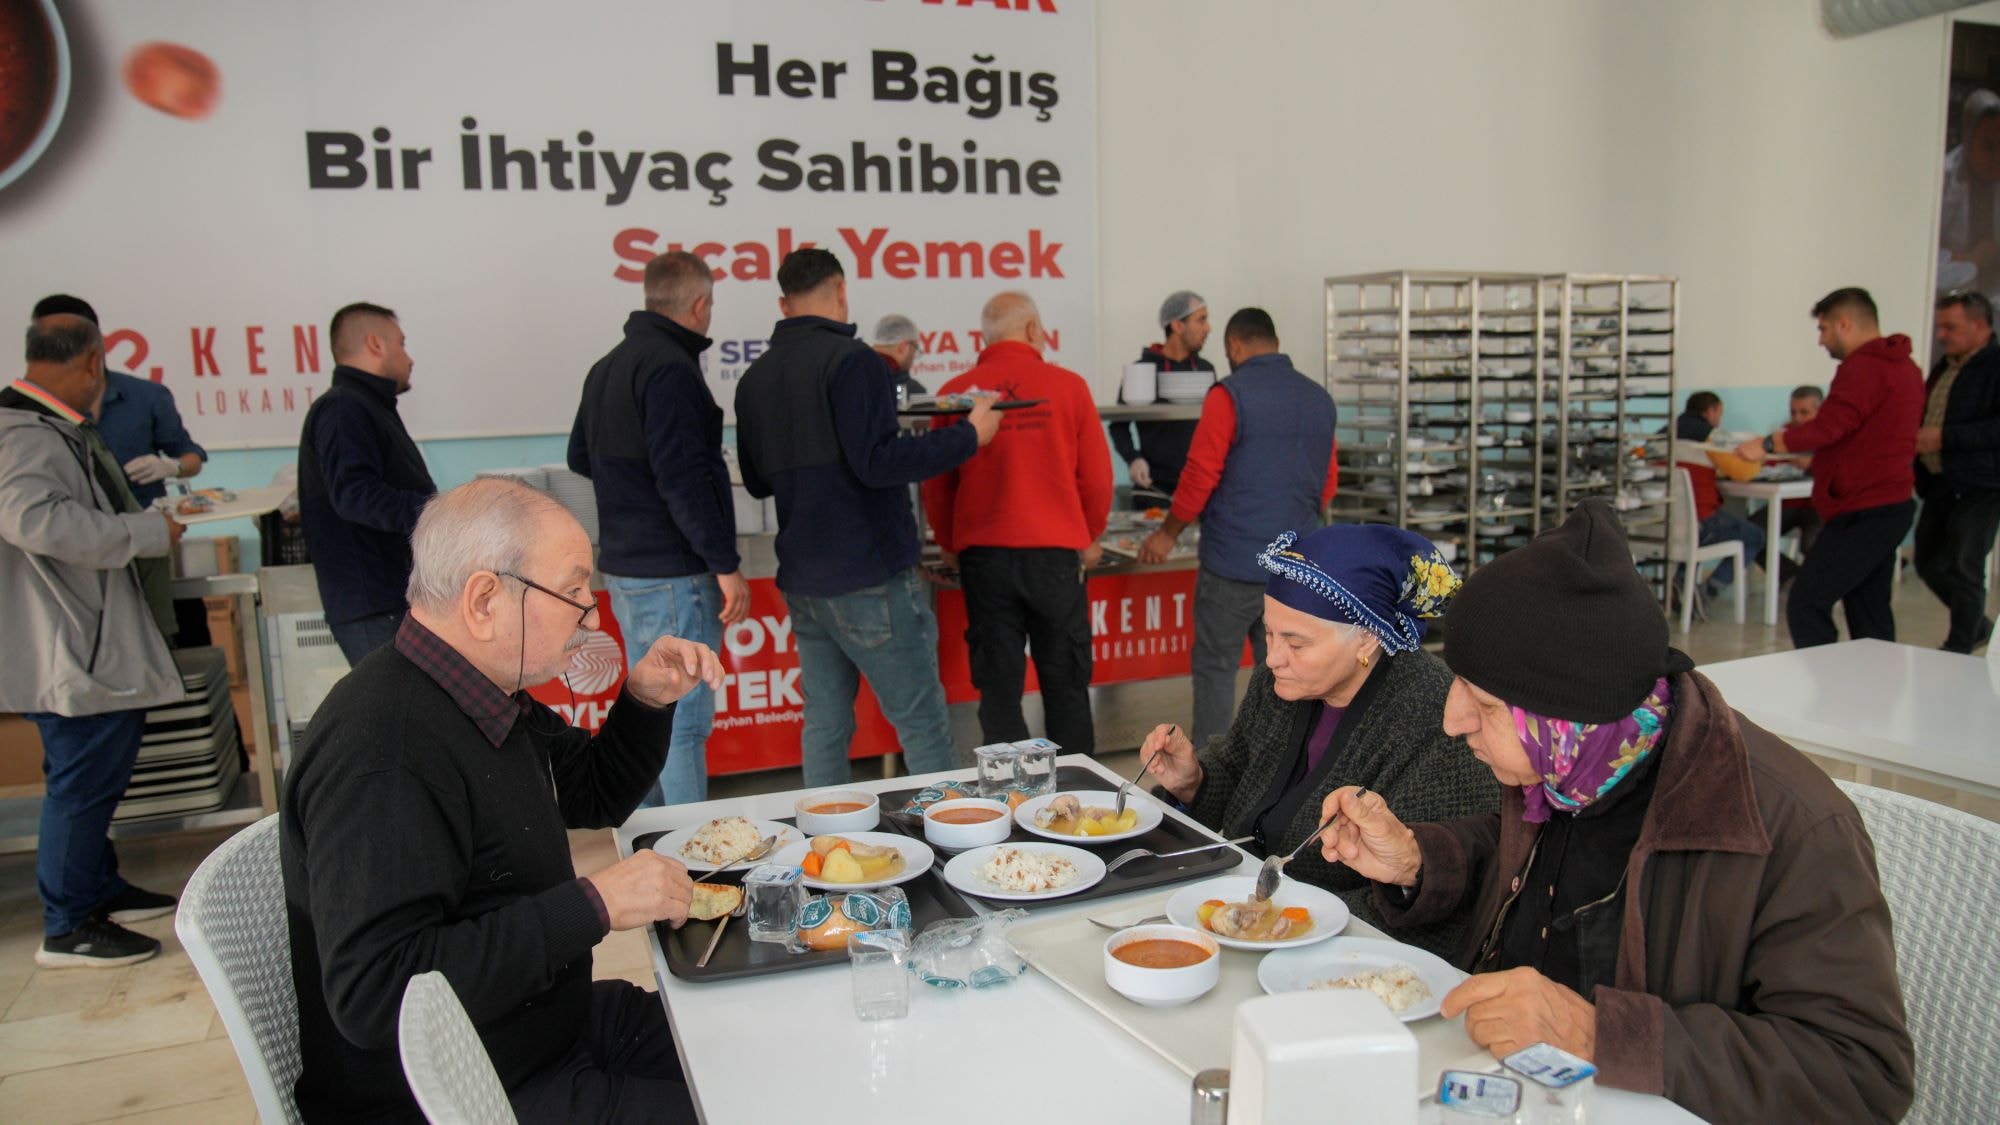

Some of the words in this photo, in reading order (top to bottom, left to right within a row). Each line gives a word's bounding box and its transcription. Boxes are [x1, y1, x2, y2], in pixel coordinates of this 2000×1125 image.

[717, 43, 846, 98] Her
[872, 50, 1058, 122] Bağış
[306, 127, 431, 190] Bir
[461, 117, 732, 206] İhtiyaç
[758, 138, 1060, 196] Sahibine
[613, 228, 817, 284] Sca
[837, 228, 1064, 279] Yemek
[724, 615, 799, 658] OY
[1092, 593, 1186, 636] KENT
